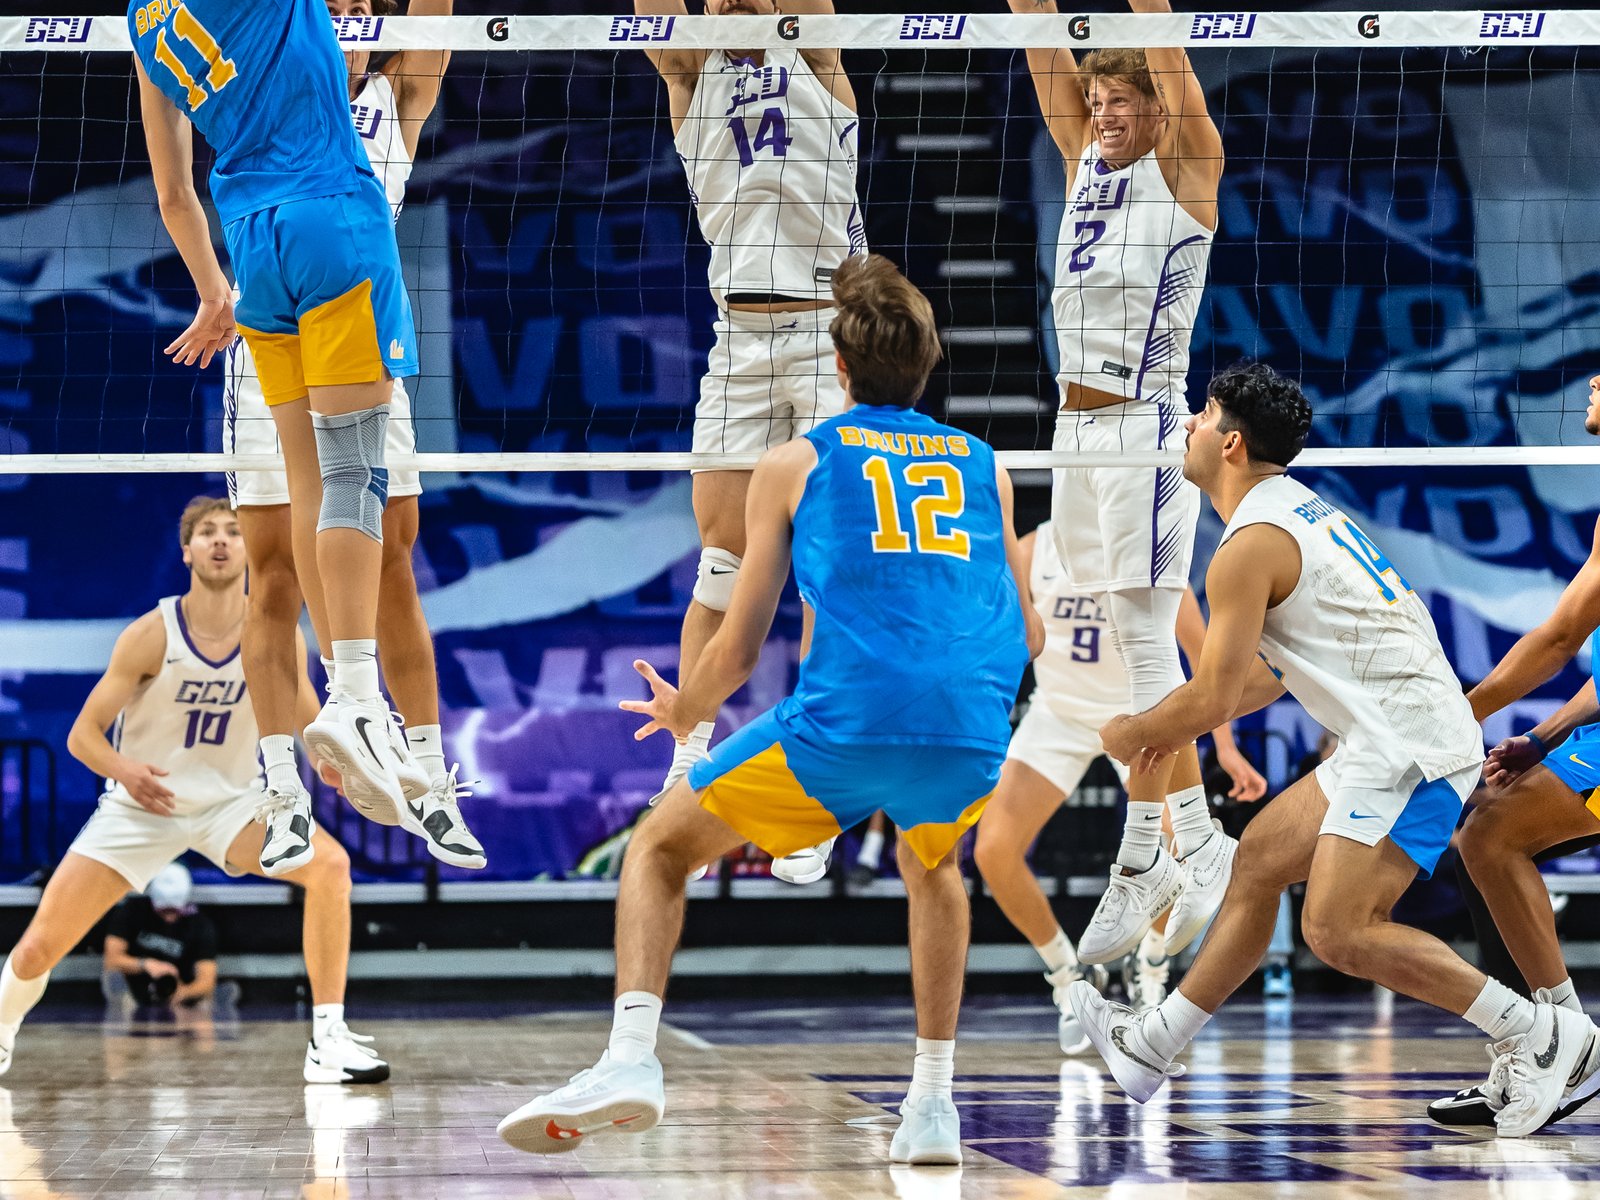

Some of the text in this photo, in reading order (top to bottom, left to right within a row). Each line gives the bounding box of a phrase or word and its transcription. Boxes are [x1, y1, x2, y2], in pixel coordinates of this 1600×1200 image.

[25, 17, 93, 43] GCU
[609, 16, 676, 42] GCU
[899, 15, 968, 41] GCU
[1189, 14, 1257, 40] GCU
[1479, 13, 1546, 39] GCU
[154, 2, 239, 113] 11
[726, 107, 794, 169] 14
[1068, 219, 1107, 274] 2
[836, 426, 971, 458] BRUINS
[861, 455, 972, 562] 12
[1292, 496, 1339, 525] BRUI
[1326, 517, 1415, 606] 14
[1071, 626, 1100, 664] 9
[175, 679, 247, 706] GCU
[184, 709, 232, 749] 10
